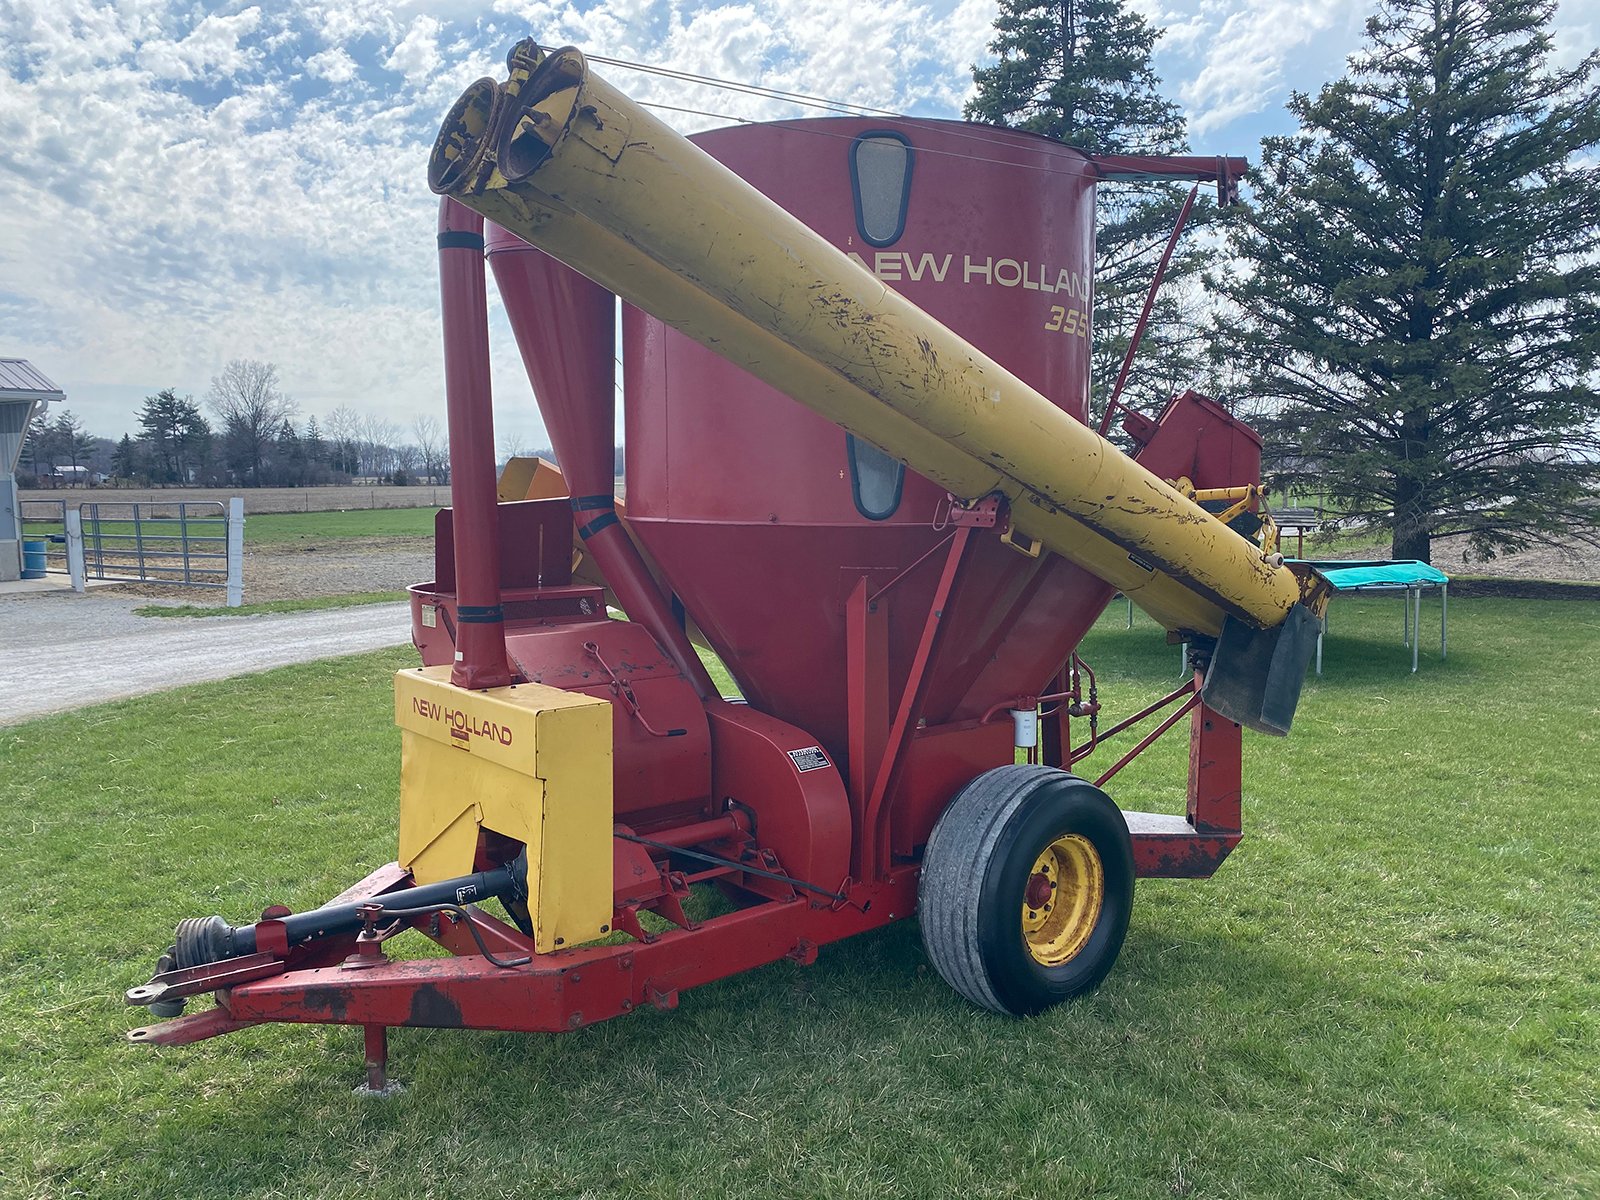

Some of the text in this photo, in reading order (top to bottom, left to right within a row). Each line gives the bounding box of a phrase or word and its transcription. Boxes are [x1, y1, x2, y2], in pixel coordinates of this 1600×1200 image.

[964, 254, 1090, 302] HOLLAND
[1044, 305, 1088, 338] 355
[413, 697, 441, 721] NEW
[444, 707, 513, 746] HOLLAND
